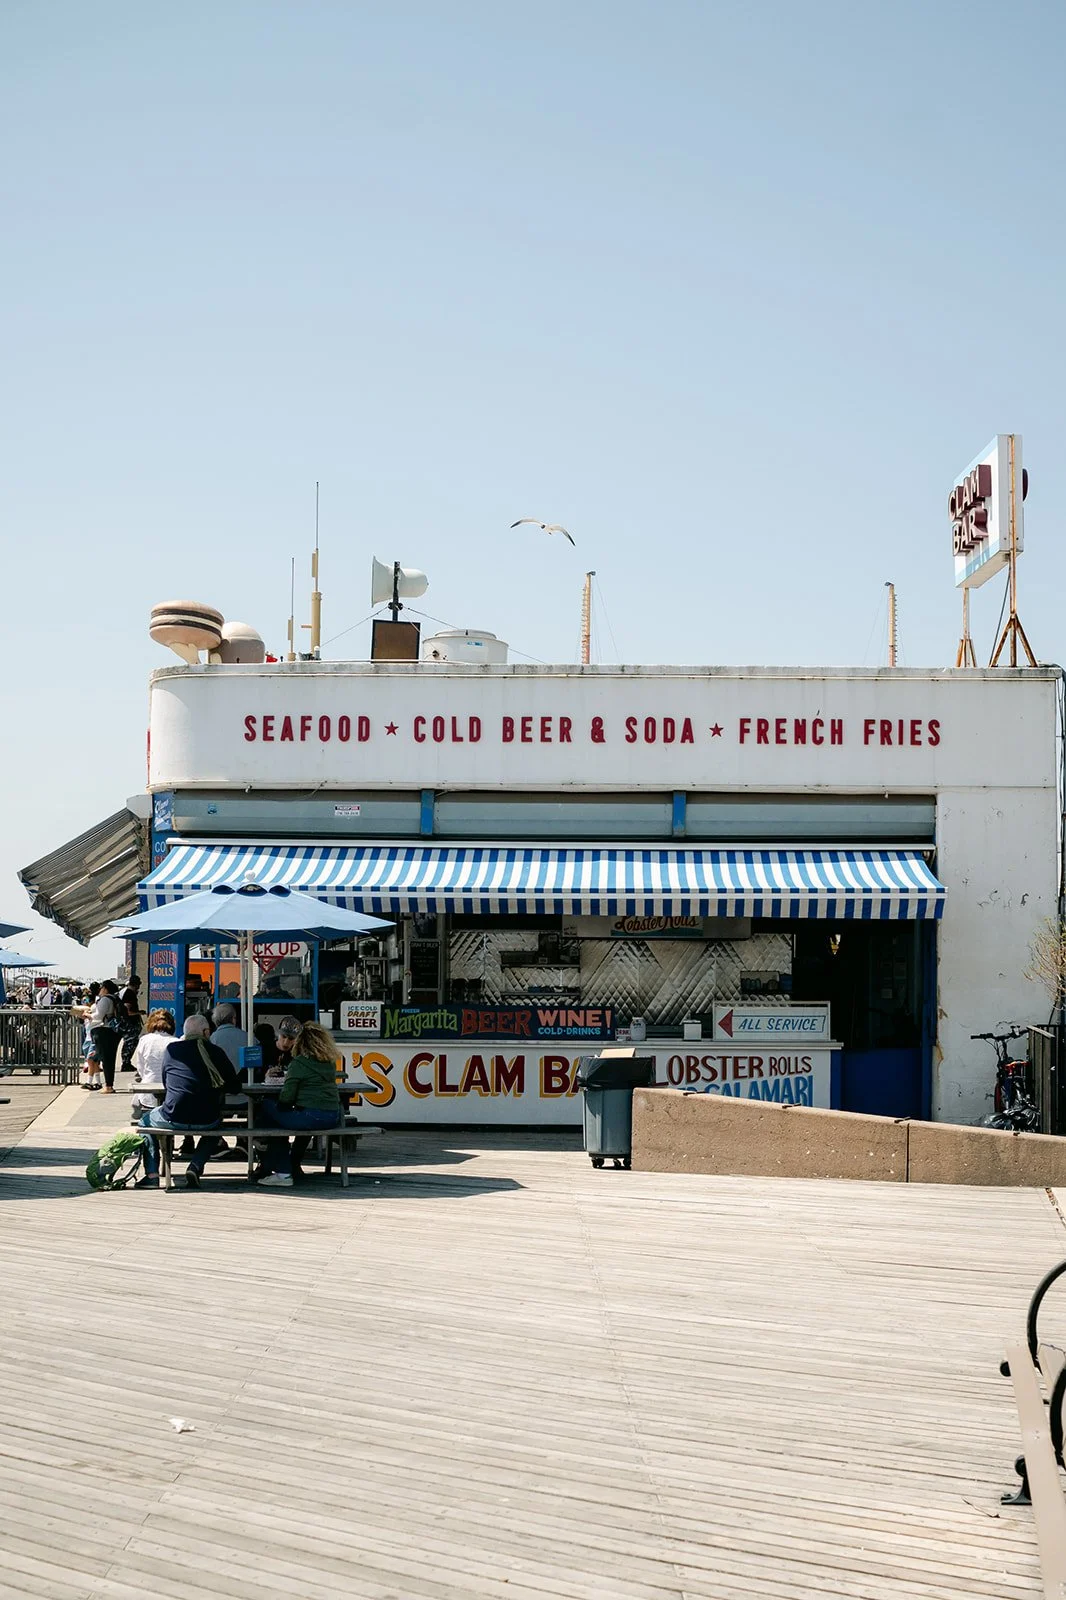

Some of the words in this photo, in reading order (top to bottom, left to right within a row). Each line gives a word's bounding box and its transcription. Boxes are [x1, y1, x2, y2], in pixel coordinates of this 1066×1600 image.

[948, 464, 992, 522] CLAM
[952, 507, 989, 557] BAR
[243, 715, 371, 742] SEAFOOD
[414, 716, 482, 743] COLD
[502, 716, 573, 743] BEER
[591, 716, 606, 743] &
[625, 717, 695, 744] SODA
[739, 718, 843, 745] FRENCH
[863, 719, 941, 746] FRIES
[150, 950, 178, 968] LOBSTER
[279, 943, 300, 955] UP
[153, 967, 174, 977] ROLLS
[348, 1018, 377, 1028] BEER
[384, 1008, 458, 1038] Margarita
[461, 1008, 532, 1036] BEER
[537, 1009, 612, 1035] WINE!
[738, 1019, 763, 1031] ALL
[767, 1018, 819, 1031] SERVICE
[403, 1052, 526, 1098] CLAM
[652, 1055, 764, 1086] LOBSTER
[769, 1056, 812, 1077] ROLLS
